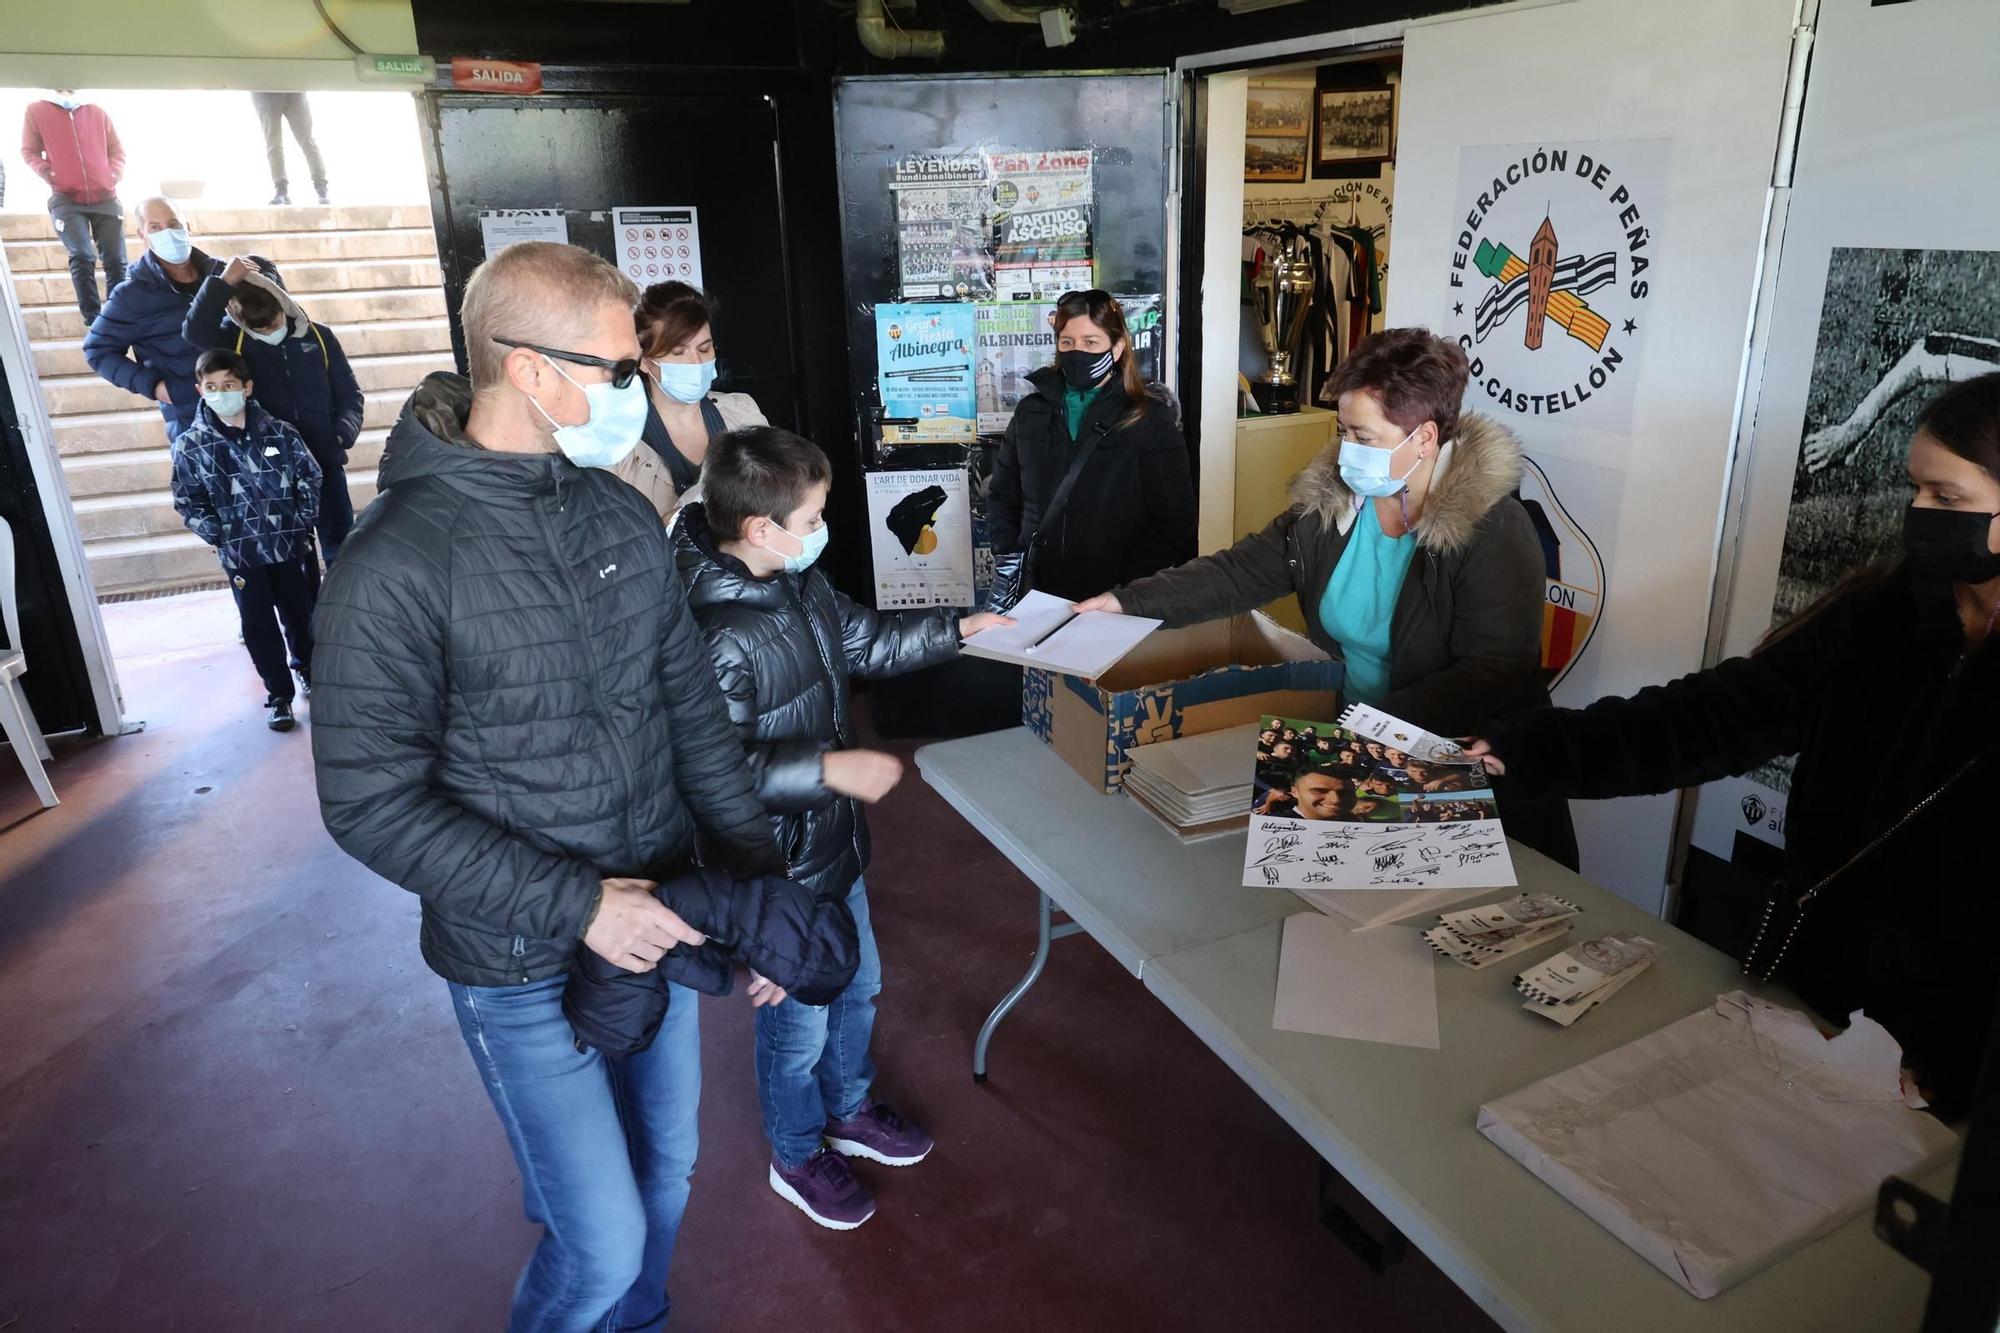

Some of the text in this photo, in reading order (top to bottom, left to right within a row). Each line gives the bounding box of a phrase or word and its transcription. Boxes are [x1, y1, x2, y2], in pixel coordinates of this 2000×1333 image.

[377, 61, 422, 72] SALIDA
[473, 69, 523, 84] SALIDA
[896, 159, 982, 174] LEYENDAS
[992, 152, 1089, 172] Fan Zone
[1366, 184, 1381, 199] DE
[1012, 208, 1079, 230] PARTIDO
[1450, 147, 1651, 299] FEDERACIÓN DE PEÑAS
[1007, 220, 1087, 243] ASCENSO
[889, 338, 963, 362] Albinegra
[910, 474, 938, 484] DONAR
[940, 473, 960, 482] VIDA
[1545, 585, 1575, 610] ON
